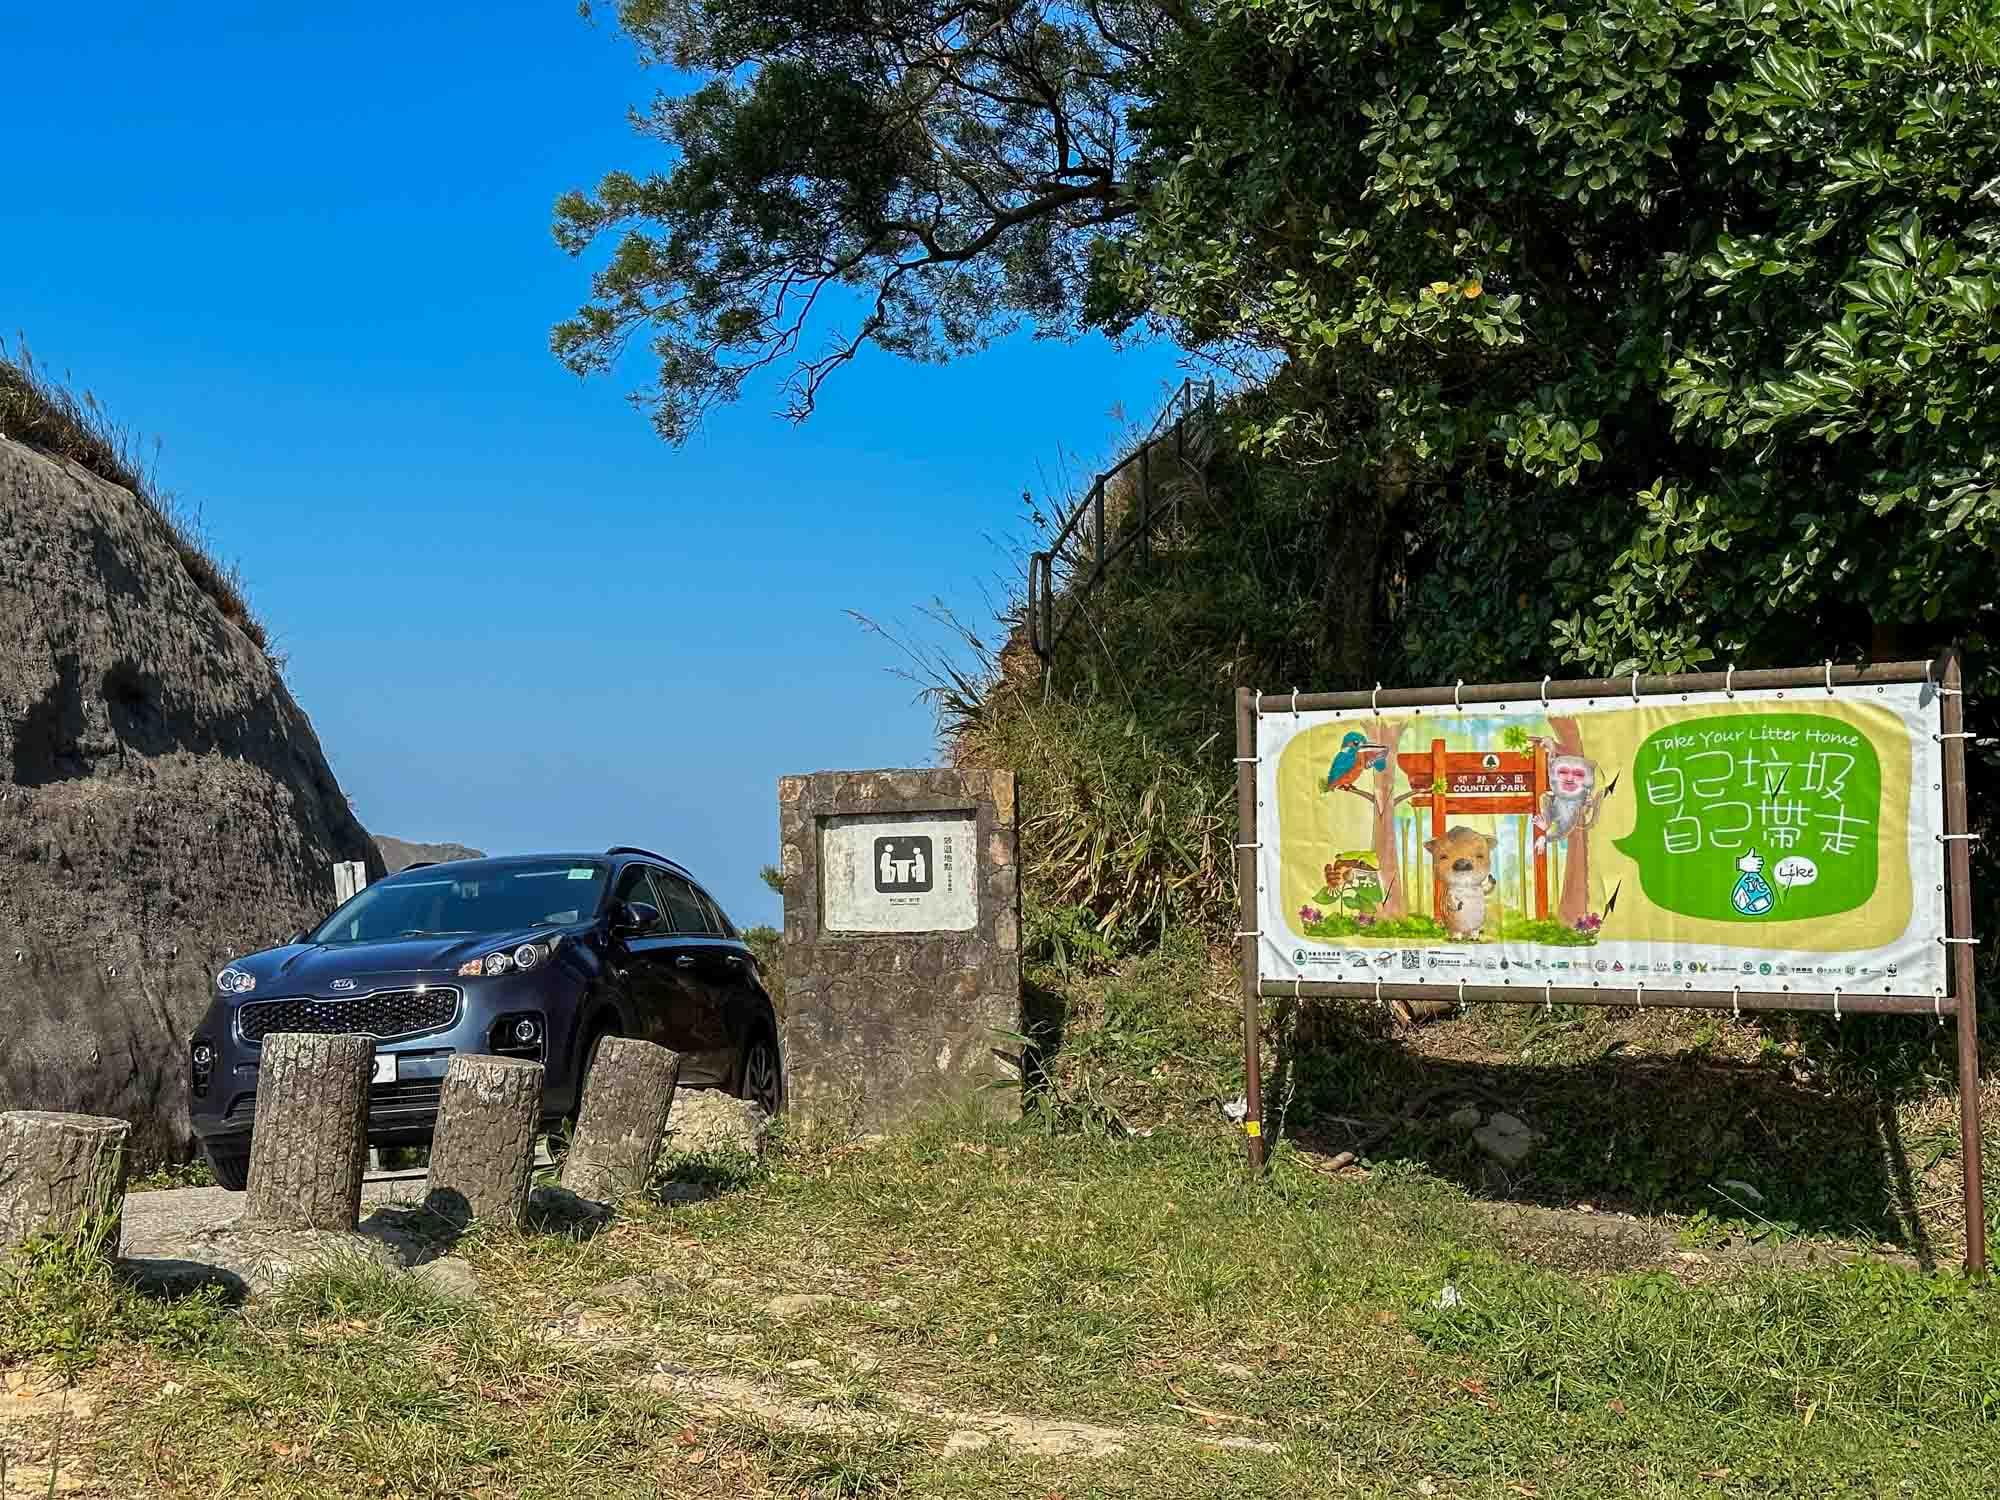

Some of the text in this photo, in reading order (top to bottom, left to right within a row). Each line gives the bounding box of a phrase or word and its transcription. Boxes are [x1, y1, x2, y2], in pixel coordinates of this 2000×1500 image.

[1652, 723, 1859, 750] Take Your Litter Home
[1453, 784, 1526, 792] COUNTRY PARK
[1646, 746, 1856, 805] 自己垃圾
[1663, 799, 1870, 855] 自己帶走
[1779, 864, 1814, 878] Like
